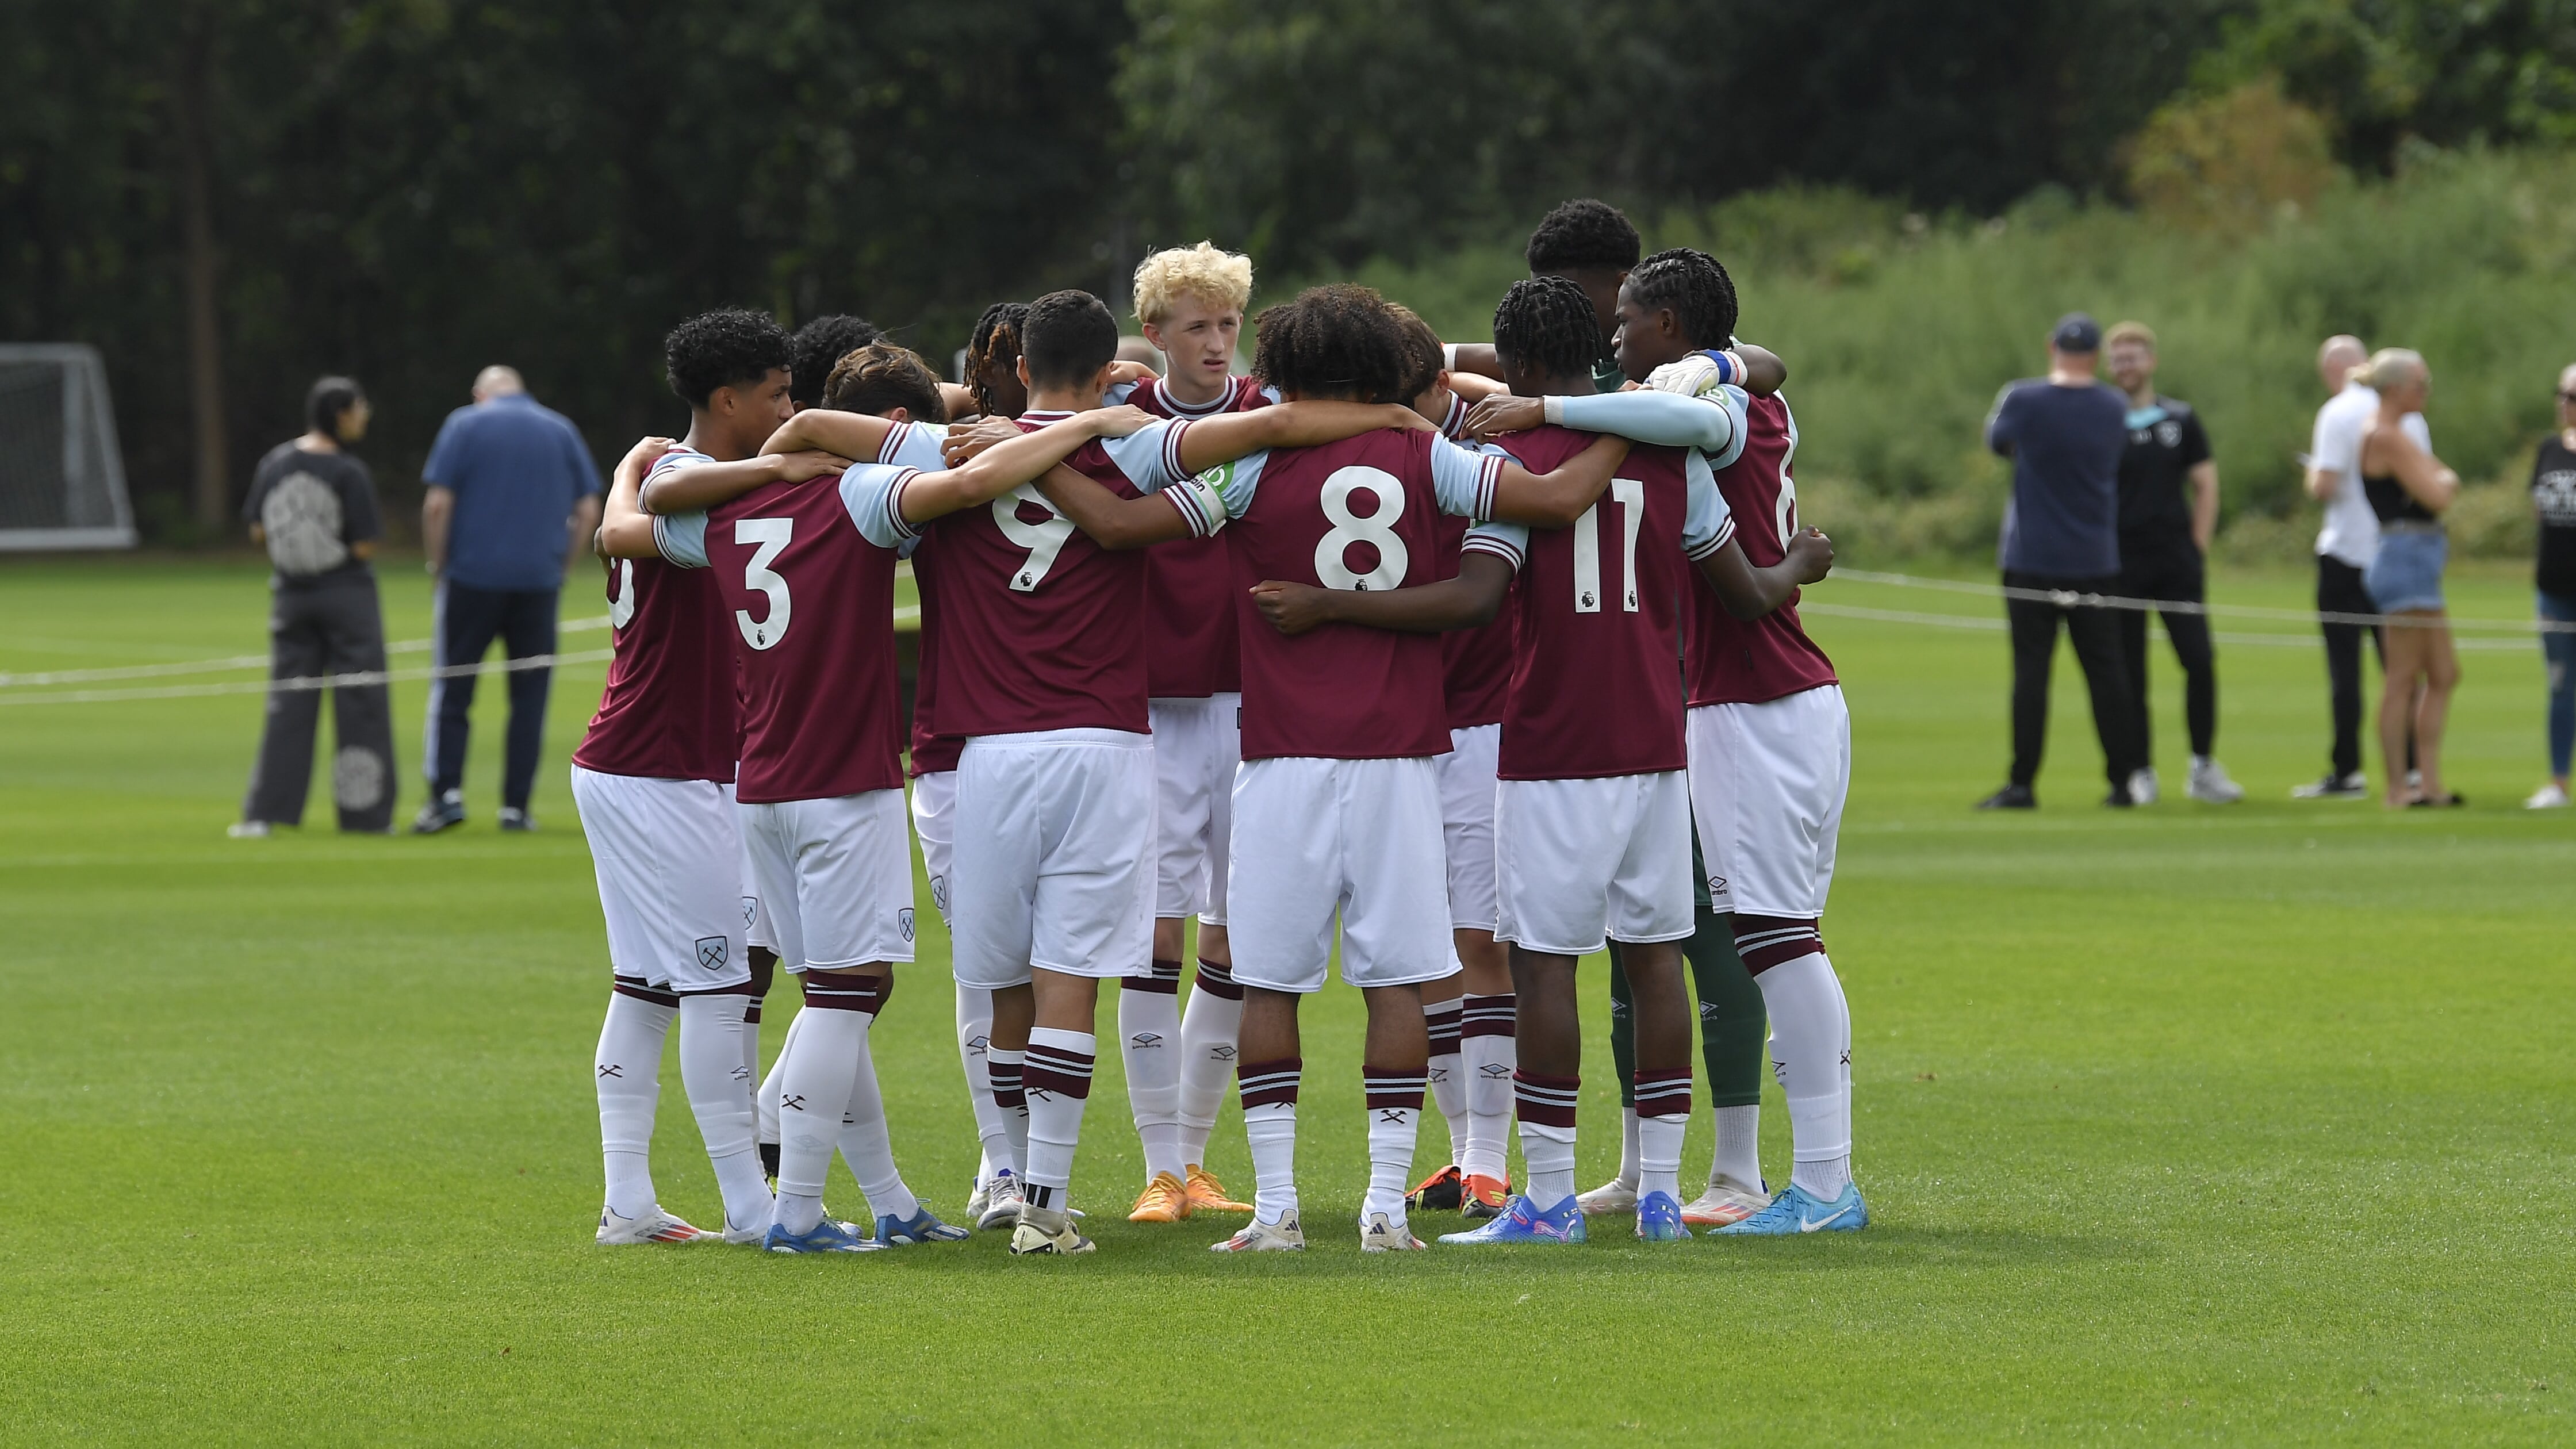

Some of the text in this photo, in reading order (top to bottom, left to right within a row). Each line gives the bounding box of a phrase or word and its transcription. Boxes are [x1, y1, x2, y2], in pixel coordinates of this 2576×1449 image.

[991, 481, 1076, 592] 9
[1190, 478, 1206, 493] ain
[1314, 466, 1408, 591] 8
[1573, 477, 1644, 613] 11
[1776, 436, 1799, 556] 6
[734, 517, 794, 651] 3
